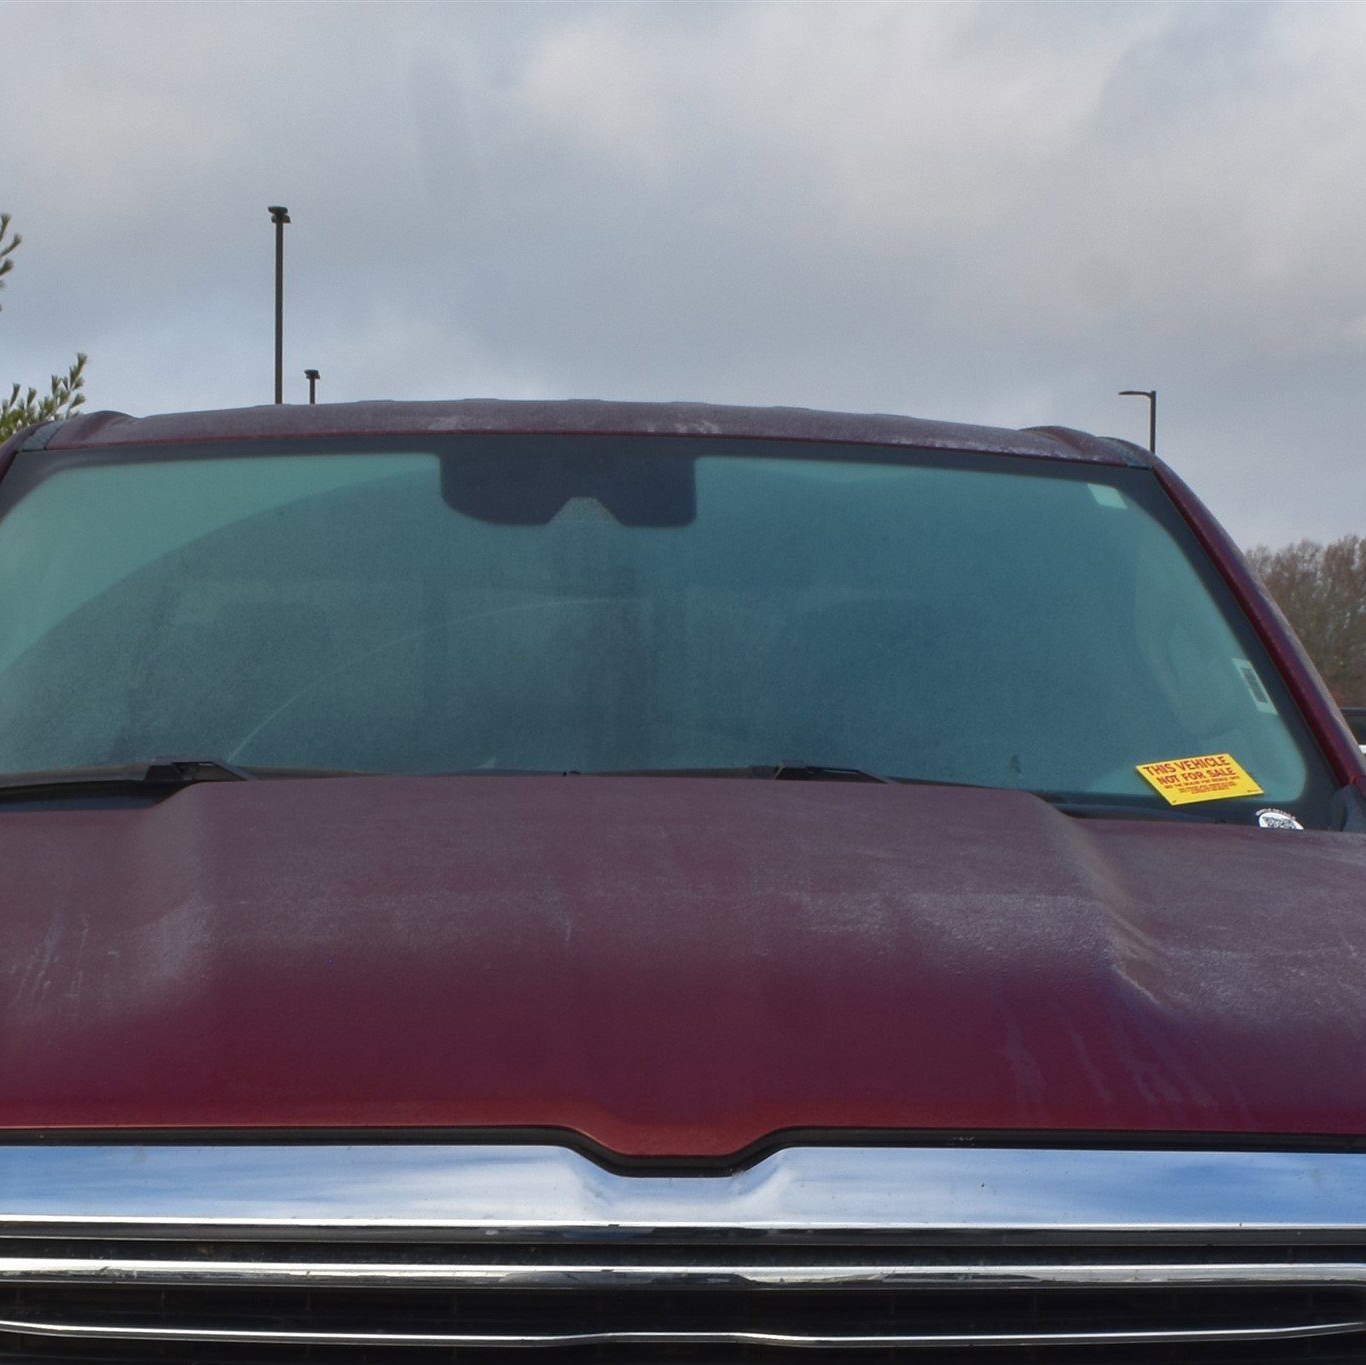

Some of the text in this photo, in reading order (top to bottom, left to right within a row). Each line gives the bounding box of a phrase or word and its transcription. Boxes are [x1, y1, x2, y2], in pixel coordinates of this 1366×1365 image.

[1143, 756, 1230, 776] THIS VEHICLE
[1156, 774, 1181, 785] NOT
[1182, 771, 1206, 781] FOR
[1206, 767, 1237, 778] SALE
